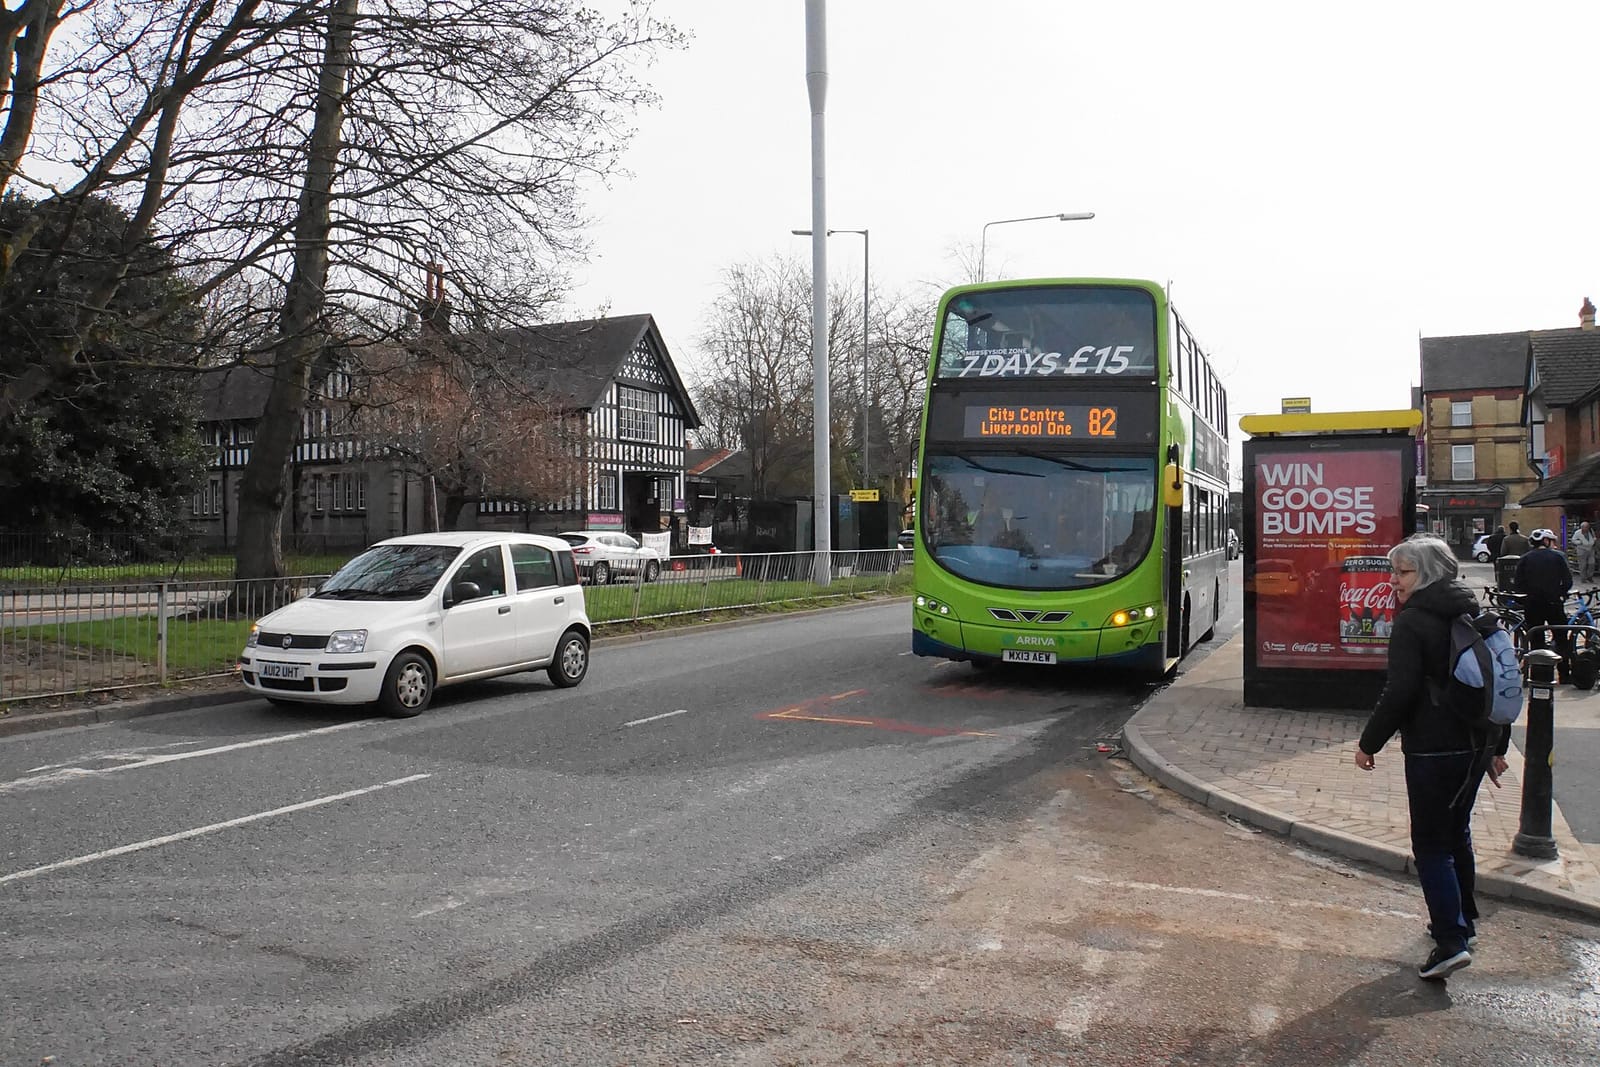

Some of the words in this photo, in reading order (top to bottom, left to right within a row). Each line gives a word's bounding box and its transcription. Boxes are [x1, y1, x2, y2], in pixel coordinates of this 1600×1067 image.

[1008, 347, 1028, 355] ZONE
[958, 356, 979, 378] 7
[979, 352, 1062, 377] DAYS
[1063, 345, 1135, 375] £15
[988, 407, 1015, 422] City
[1020, 408, 1065, 422] Centre
[1088, 407, 1117, 436] 82
[981, 421, 1042, 435] Liverpool
[1047, 422, 1072, 435] One
[1261, 463, 1324, 486] WIN
[1262, 486, 1375, 511] GOOSE
[1262, 511, 1377, 535] BUMPS
[1344, 559, 1364, 567] ZERO
[1016, 636, 1056, 646] ARRIVA
[1008, 651, 1030, 661] MX13
[1032, 652, 1051, 662] AEW
[263, 665, 280, 677] AU12
[282, 666, 299, 678] UHT
